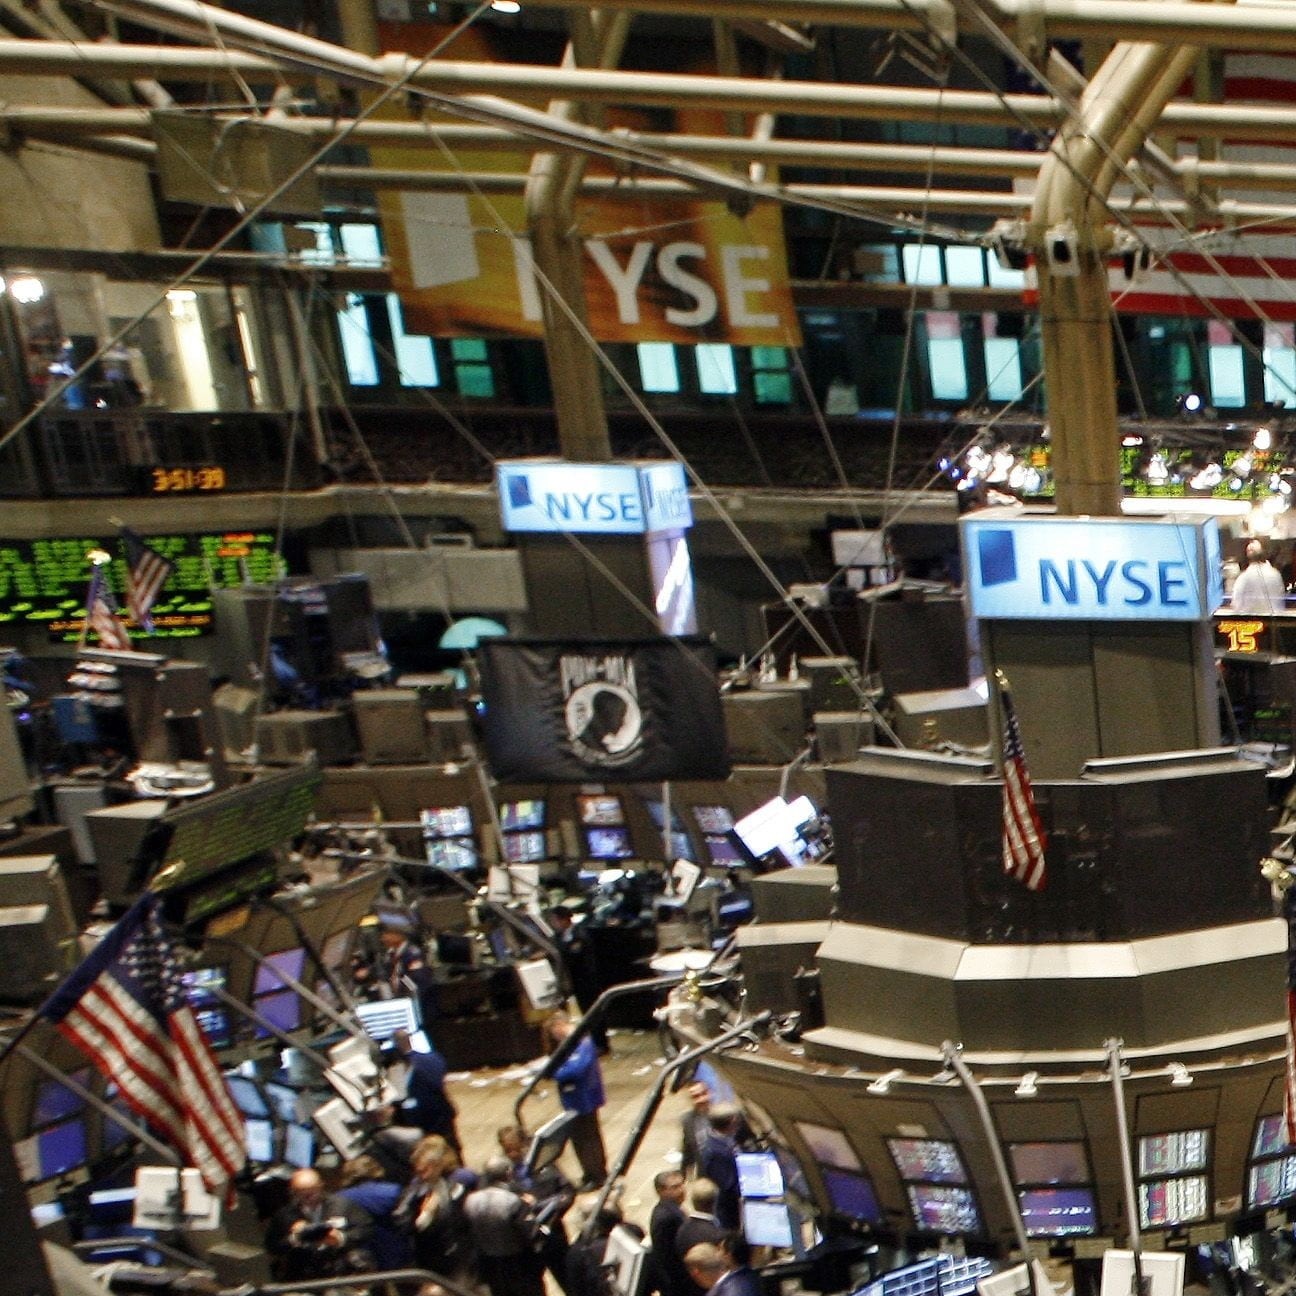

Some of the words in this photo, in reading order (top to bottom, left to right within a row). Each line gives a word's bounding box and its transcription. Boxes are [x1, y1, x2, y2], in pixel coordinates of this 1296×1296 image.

[545, 493, 641, 521] NYSE
[1039, 559, 1189, 606] NYSE
[1228, 629, 1258, 653] 15
